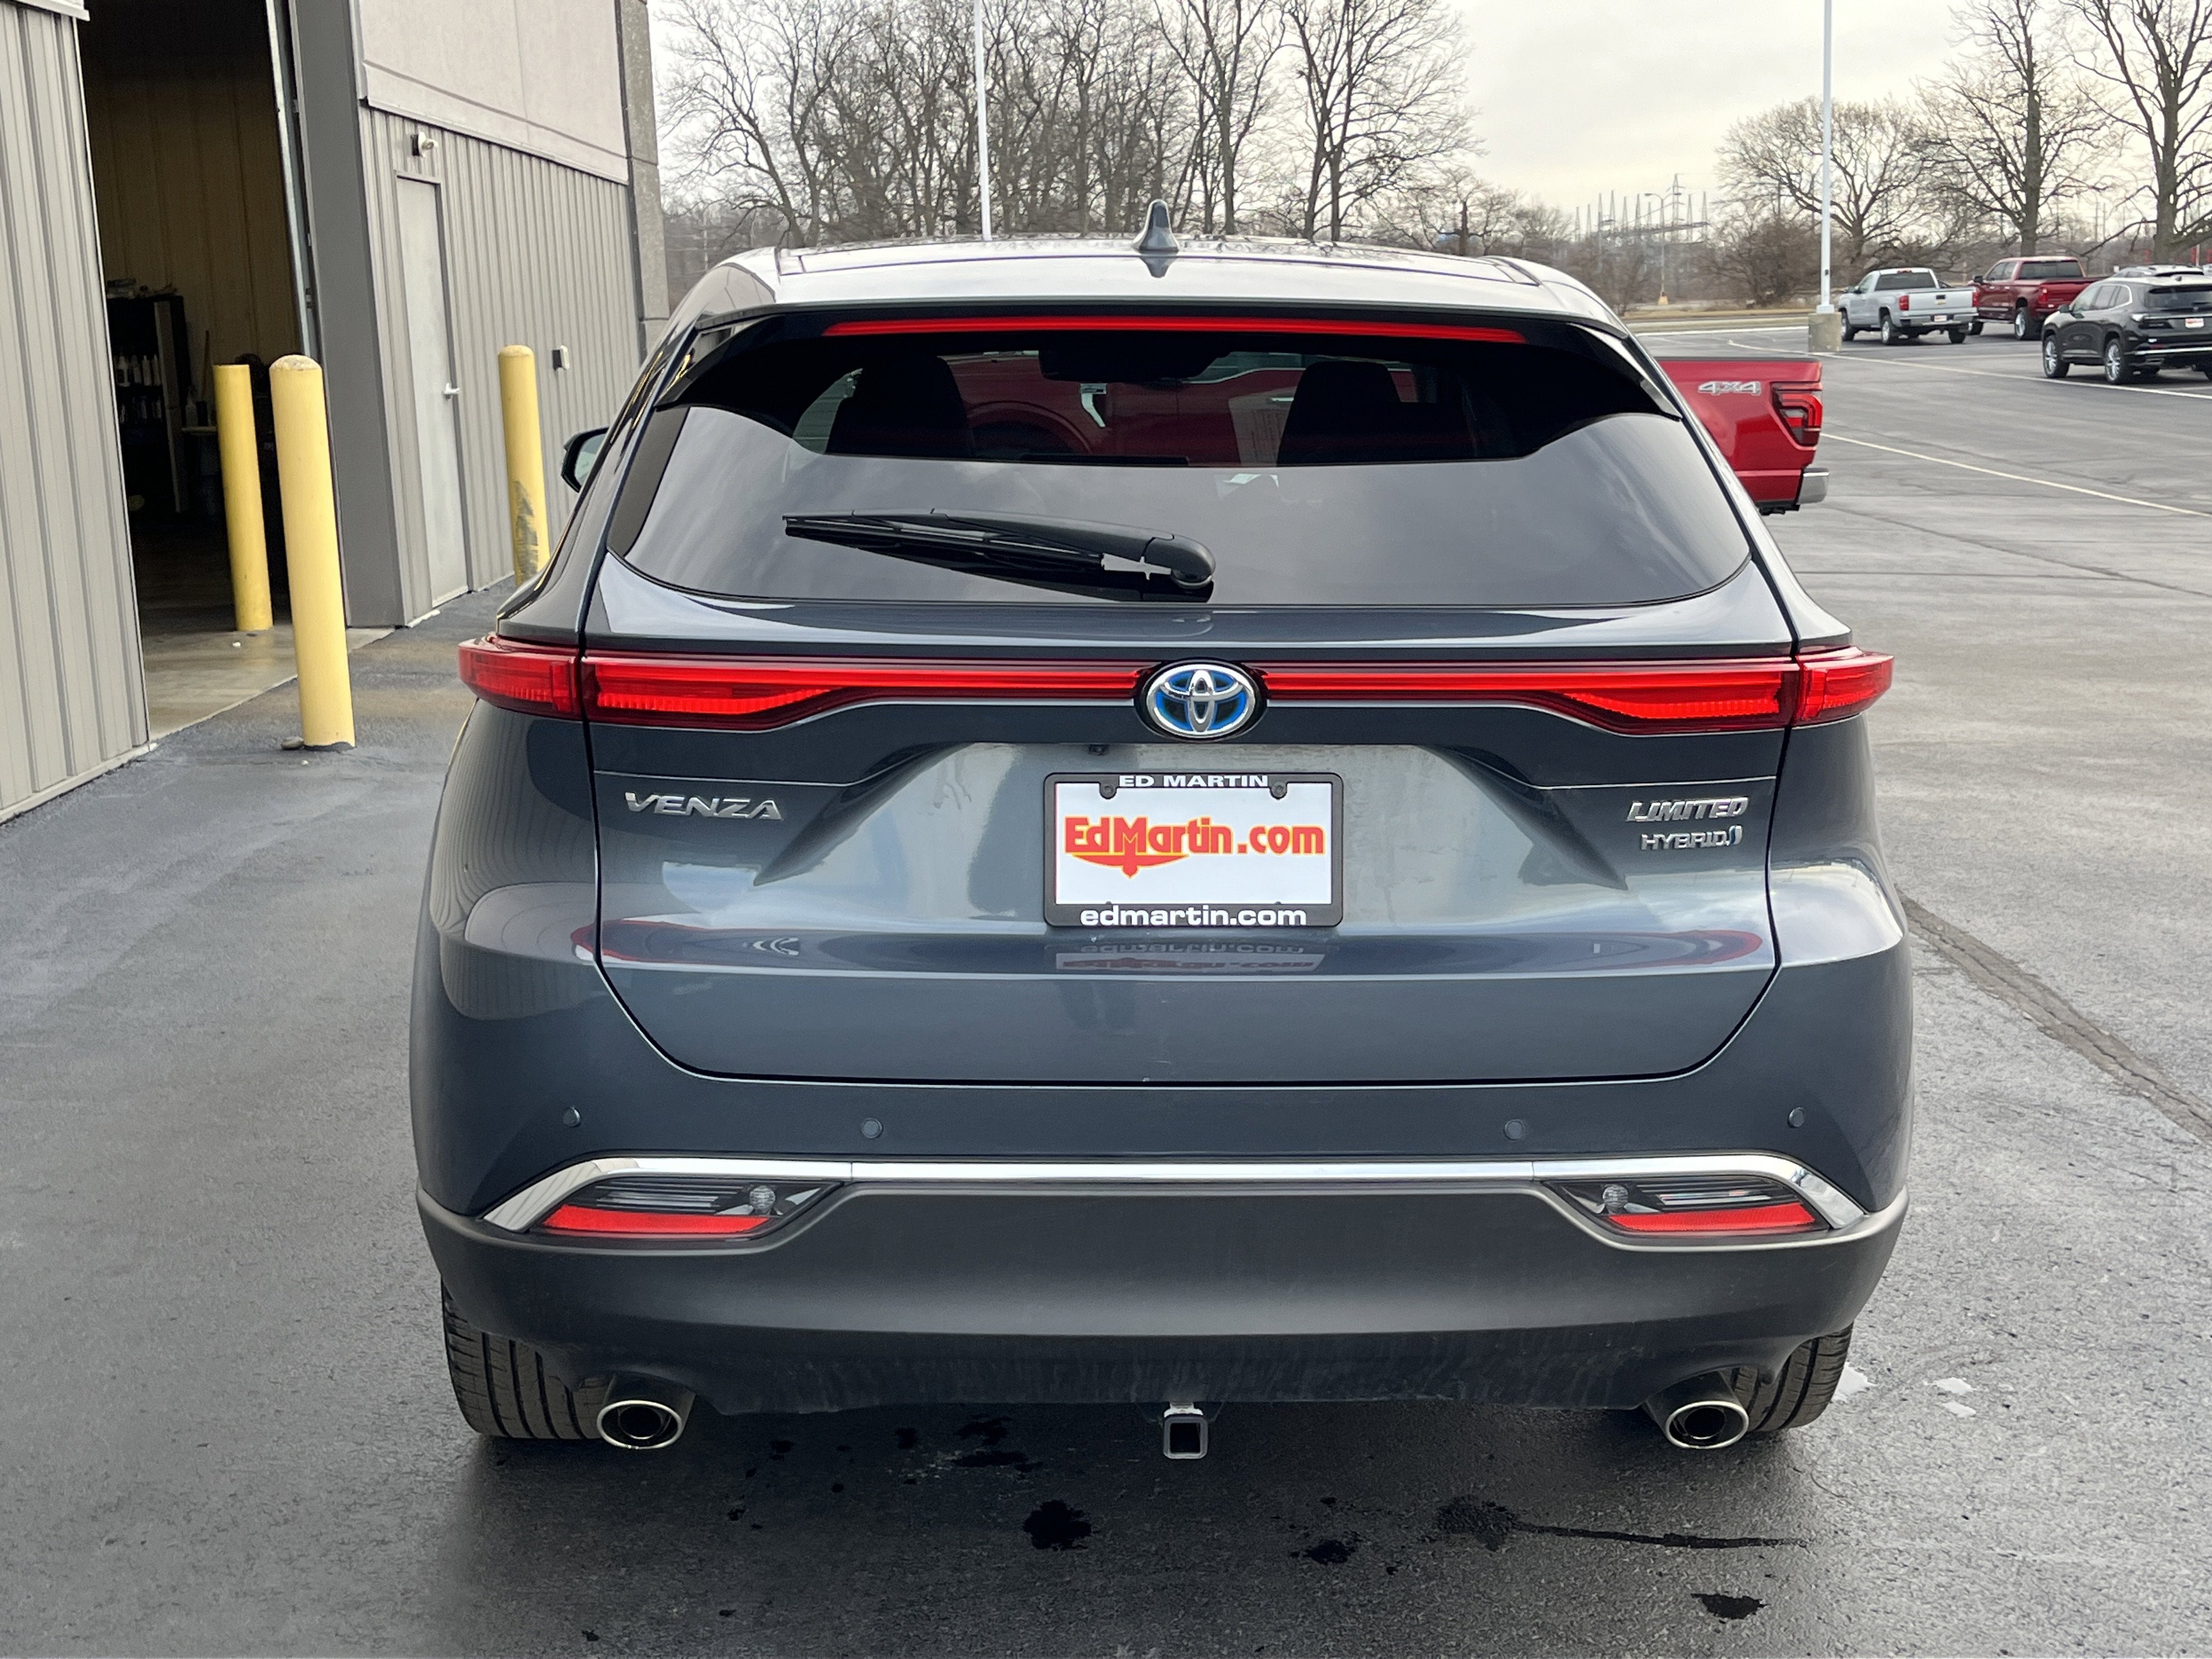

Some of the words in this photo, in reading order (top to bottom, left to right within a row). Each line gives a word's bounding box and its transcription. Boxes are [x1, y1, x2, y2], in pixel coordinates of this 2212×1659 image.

[1119, 775, 1155, 787] ED
[1164, 775, 1268, 787] MARTIN
[625, 792, 783, 821] VENZA
[1625, 797, 1749, 822] LIMITED
[1064, 816, 1325, 855] EdMartin.com
[1641, 831, 1727, 850] HYBRID
[1080, 905, 1307, 927] edmartin.com
